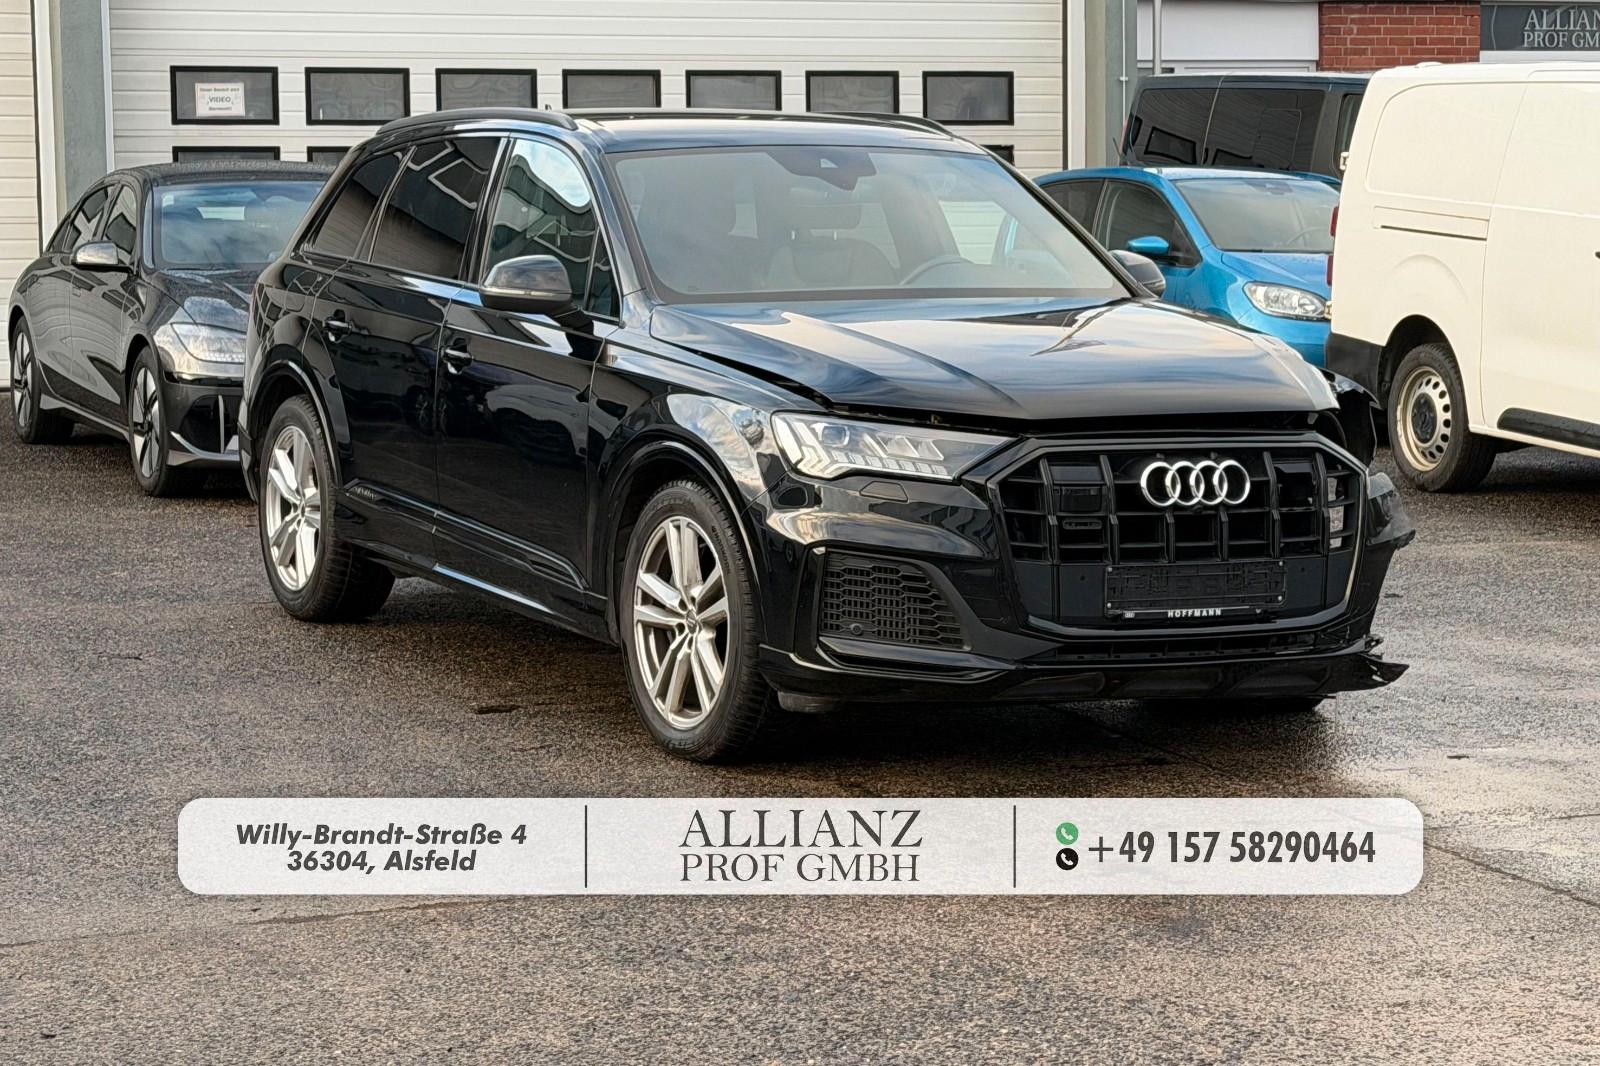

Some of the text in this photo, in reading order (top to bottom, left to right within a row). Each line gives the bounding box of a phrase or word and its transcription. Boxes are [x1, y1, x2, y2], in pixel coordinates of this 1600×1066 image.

[1523, 31, 1600, 48] PROF GM
[1167, 608, 1222, 618] HOFFMANN
